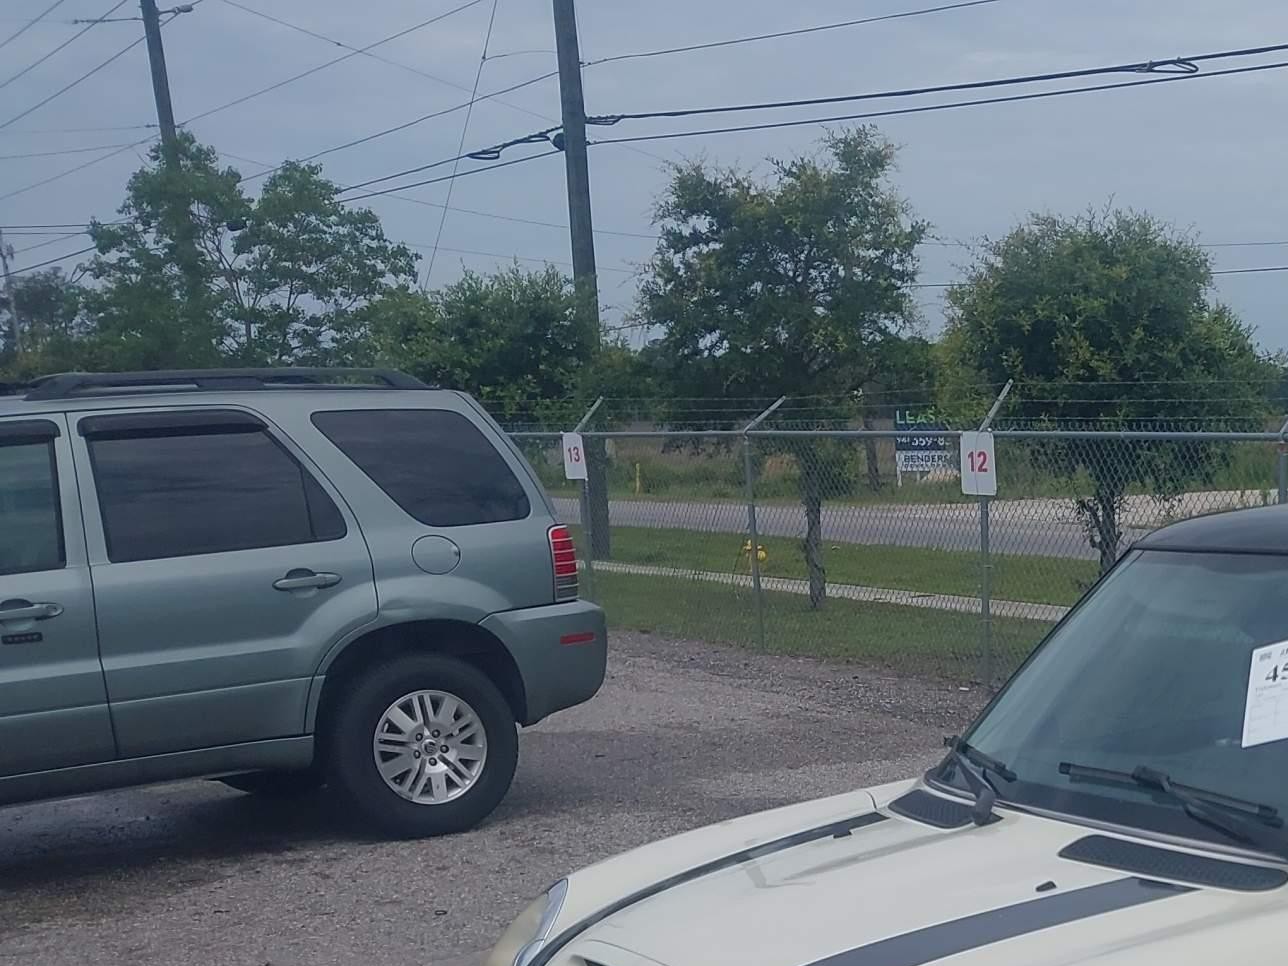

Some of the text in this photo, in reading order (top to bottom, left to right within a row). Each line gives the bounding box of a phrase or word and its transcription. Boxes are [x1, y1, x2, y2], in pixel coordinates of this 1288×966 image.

[896, 409, 937, 424] LEAS
[567, 446, 581, 463] 13
[968, 450, 989, 473] 12
